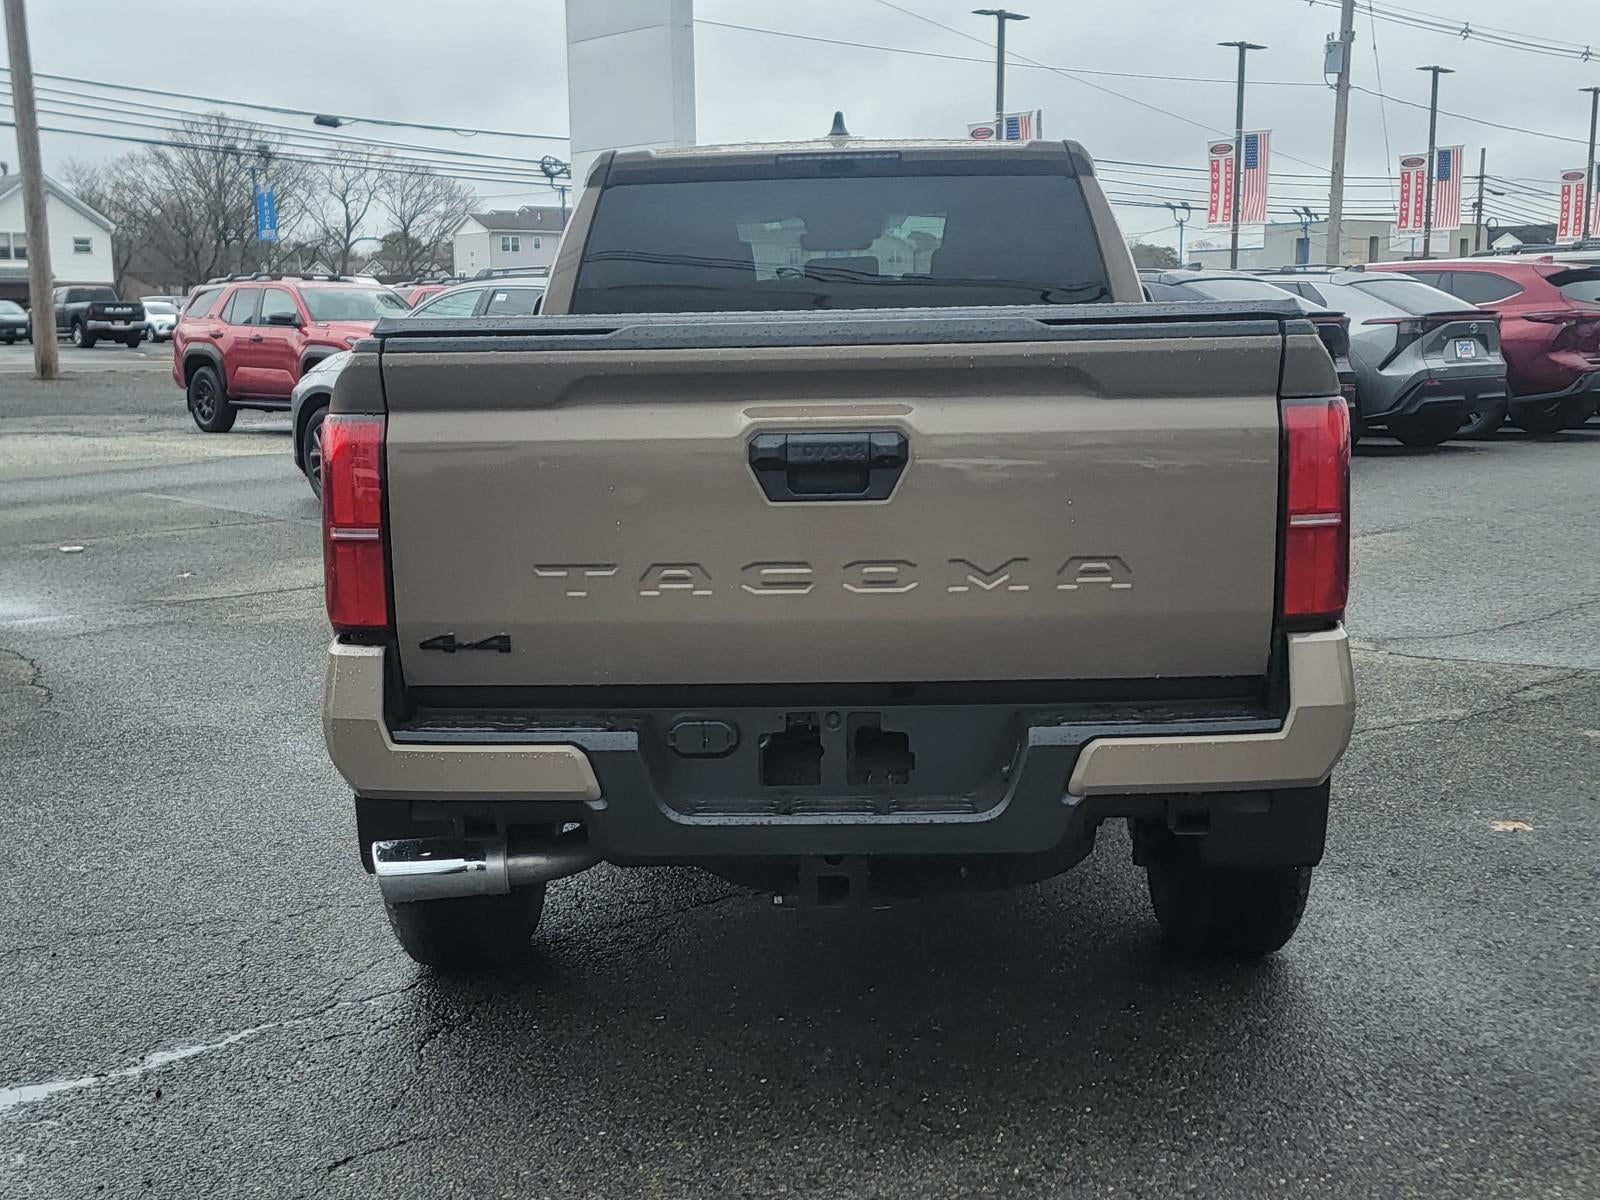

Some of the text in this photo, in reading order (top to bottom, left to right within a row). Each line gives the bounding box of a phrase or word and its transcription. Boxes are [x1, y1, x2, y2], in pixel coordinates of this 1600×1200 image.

[1210, 161, 1219, 220] TOYOTA
[1400, 173, 1409, 227] TOYOTA
[1560, 186, 1569, 236] TOYOTA
[532, 556, 1133, 598] TACOMA
